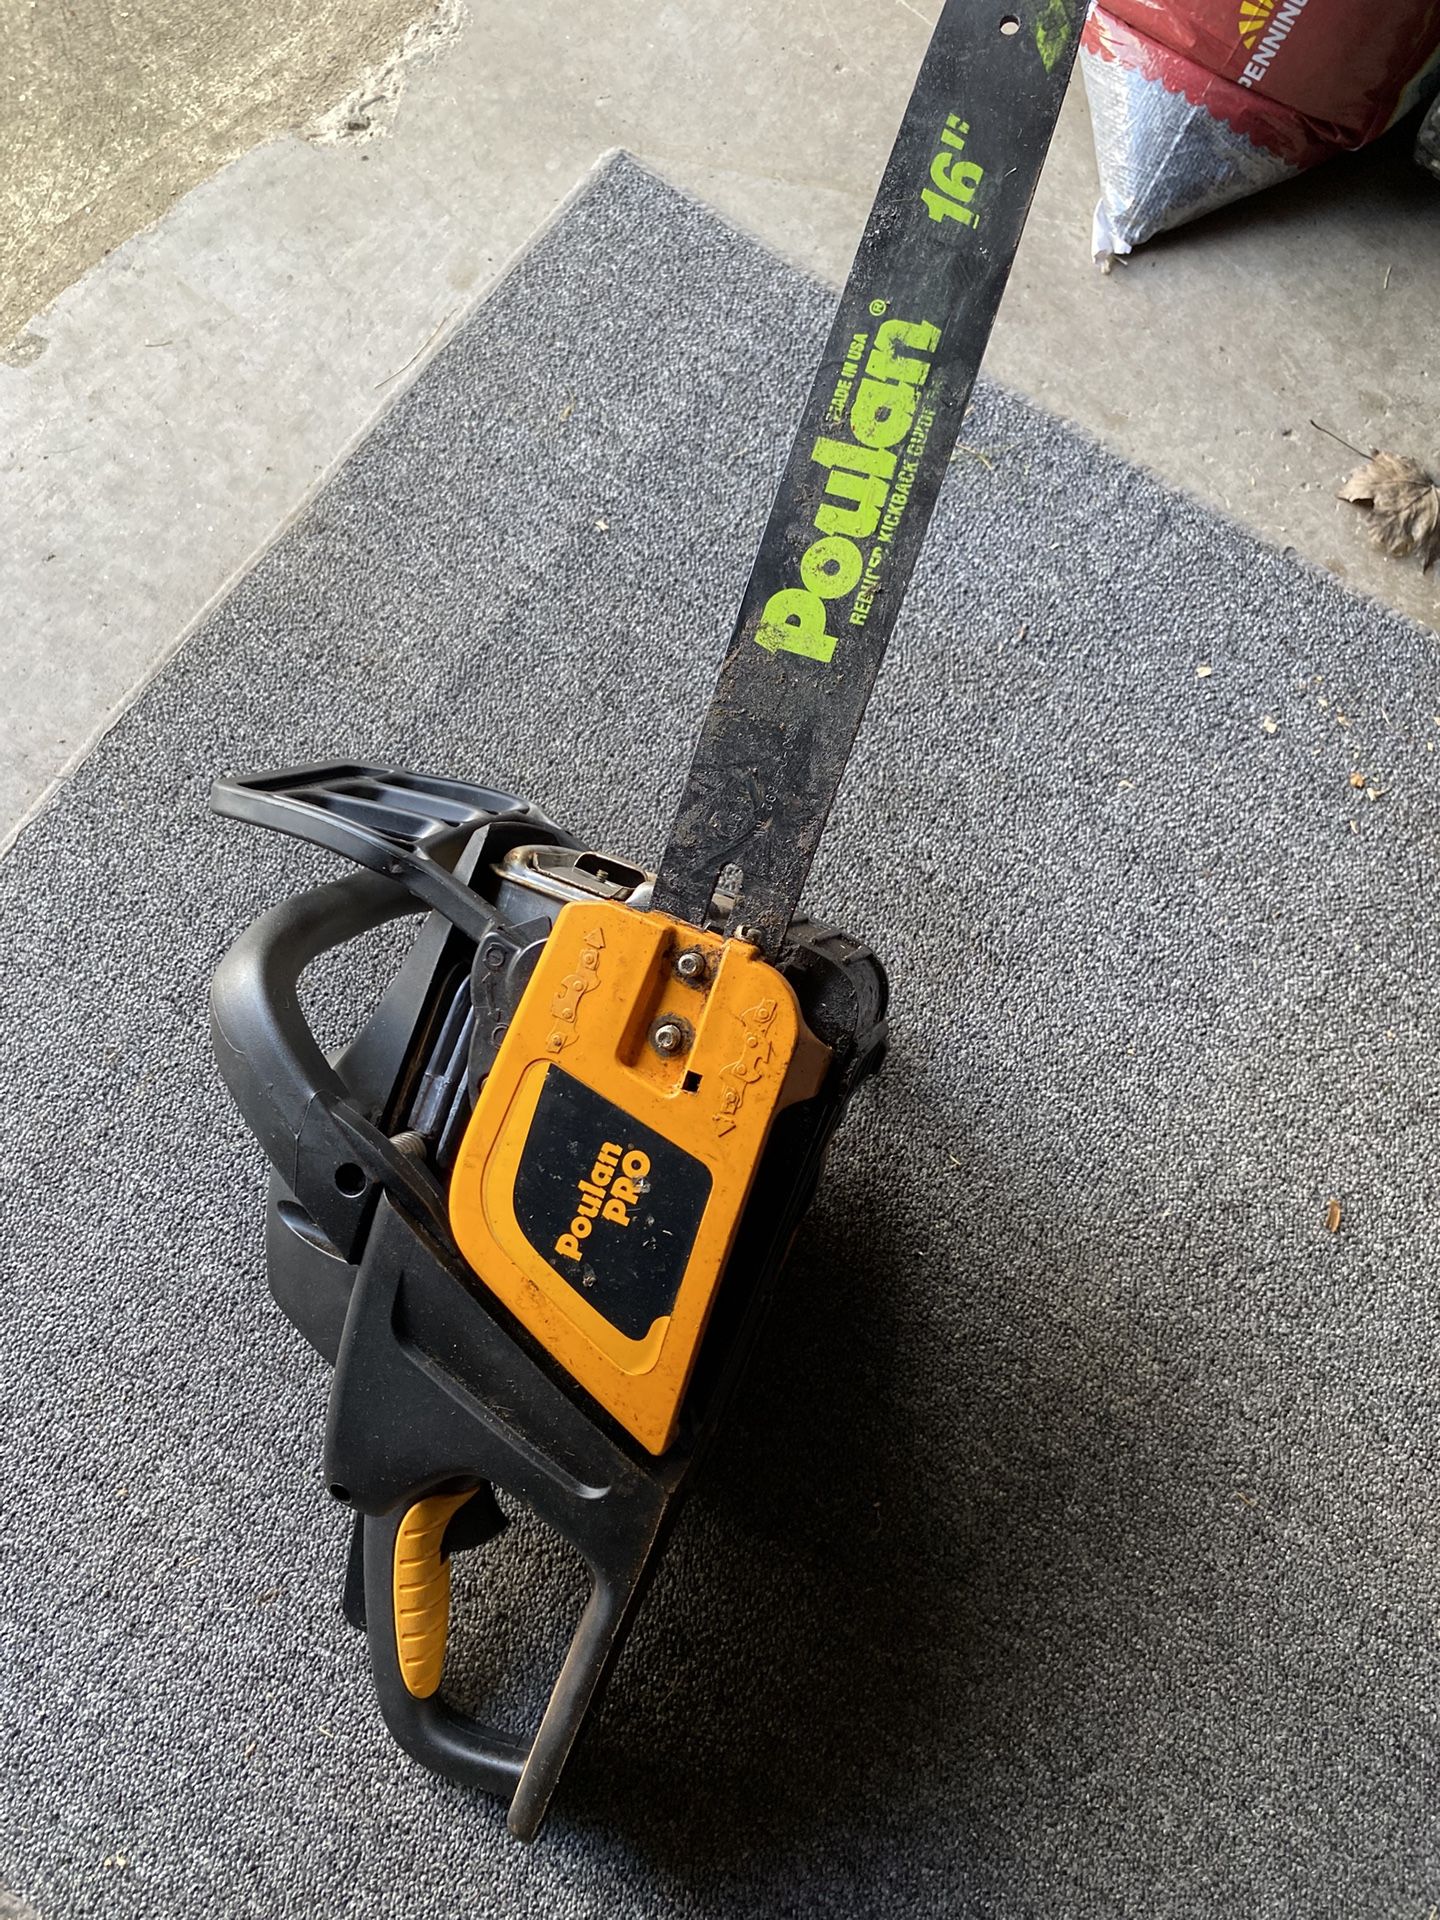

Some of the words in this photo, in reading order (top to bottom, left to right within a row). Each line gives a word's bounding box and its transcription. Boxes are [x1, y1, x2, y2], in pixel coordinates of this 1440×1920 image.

[1237, 0, 1309, 88] PENNIN
[841, 361, 858, 378] IN
[847, 333, 868, 360] USA
[754, 319, 941, 663] Poulan
[877, 458, 919, 544] KICKBACK
[554, 1141, 623, 1262] Poulan
[601, 1150, 651, 1227] PRO
